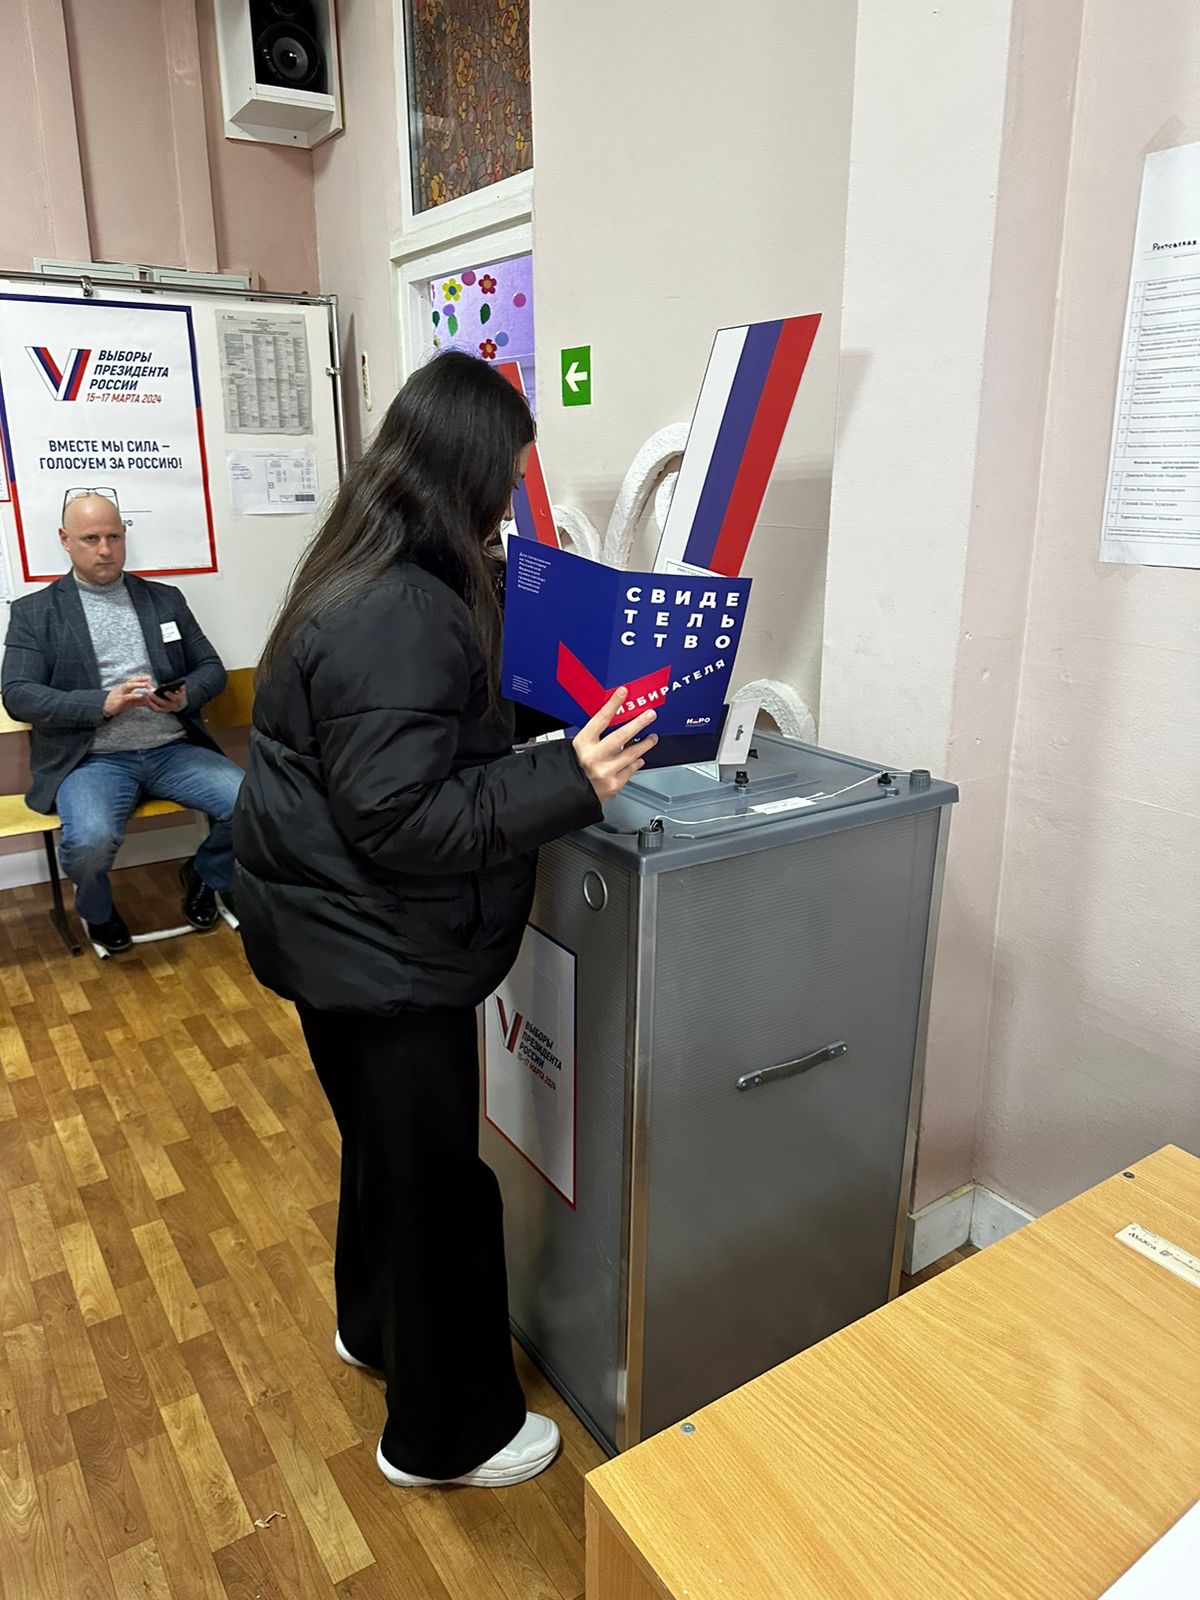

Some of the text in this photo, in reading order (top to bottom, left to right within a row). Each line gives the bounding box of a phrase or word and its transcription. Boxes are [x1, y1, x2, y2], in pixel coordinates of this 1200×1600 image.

[98, 350, 152, 362] ВЫБОРЫ
[94, 365, 169, 378] ПРЕЗИДЕНТА
[90, 379, 138, 390] РОССИИ
[111, 394, 140, 403] МАРТА
[142, 394, 162, 404] 2024
[49, 440, 98, 452] ВМЕСТЕ
[102, 441, 123, 452] МЫ
[127, 441, 159, 452] СИЛА
[40, 457, 182, 469] ГОЛОСУЕМ ЗА РОССИЮ!
[626, 587, 740, 609] СВИДЕ
[624, 609, 735, 628] ТЕЛЬ
[620, 631, 731, 649] СТВО
[615, 659, 726, 716] ИЗБИРАТЕЛЯ
[525, 1021, 554, 1049] ВЫБОРЫ
[519, 1042, 544, 1068] РОССИИ
[522, 1032, 562, 1071] ПРЕЗИДЕНТА
